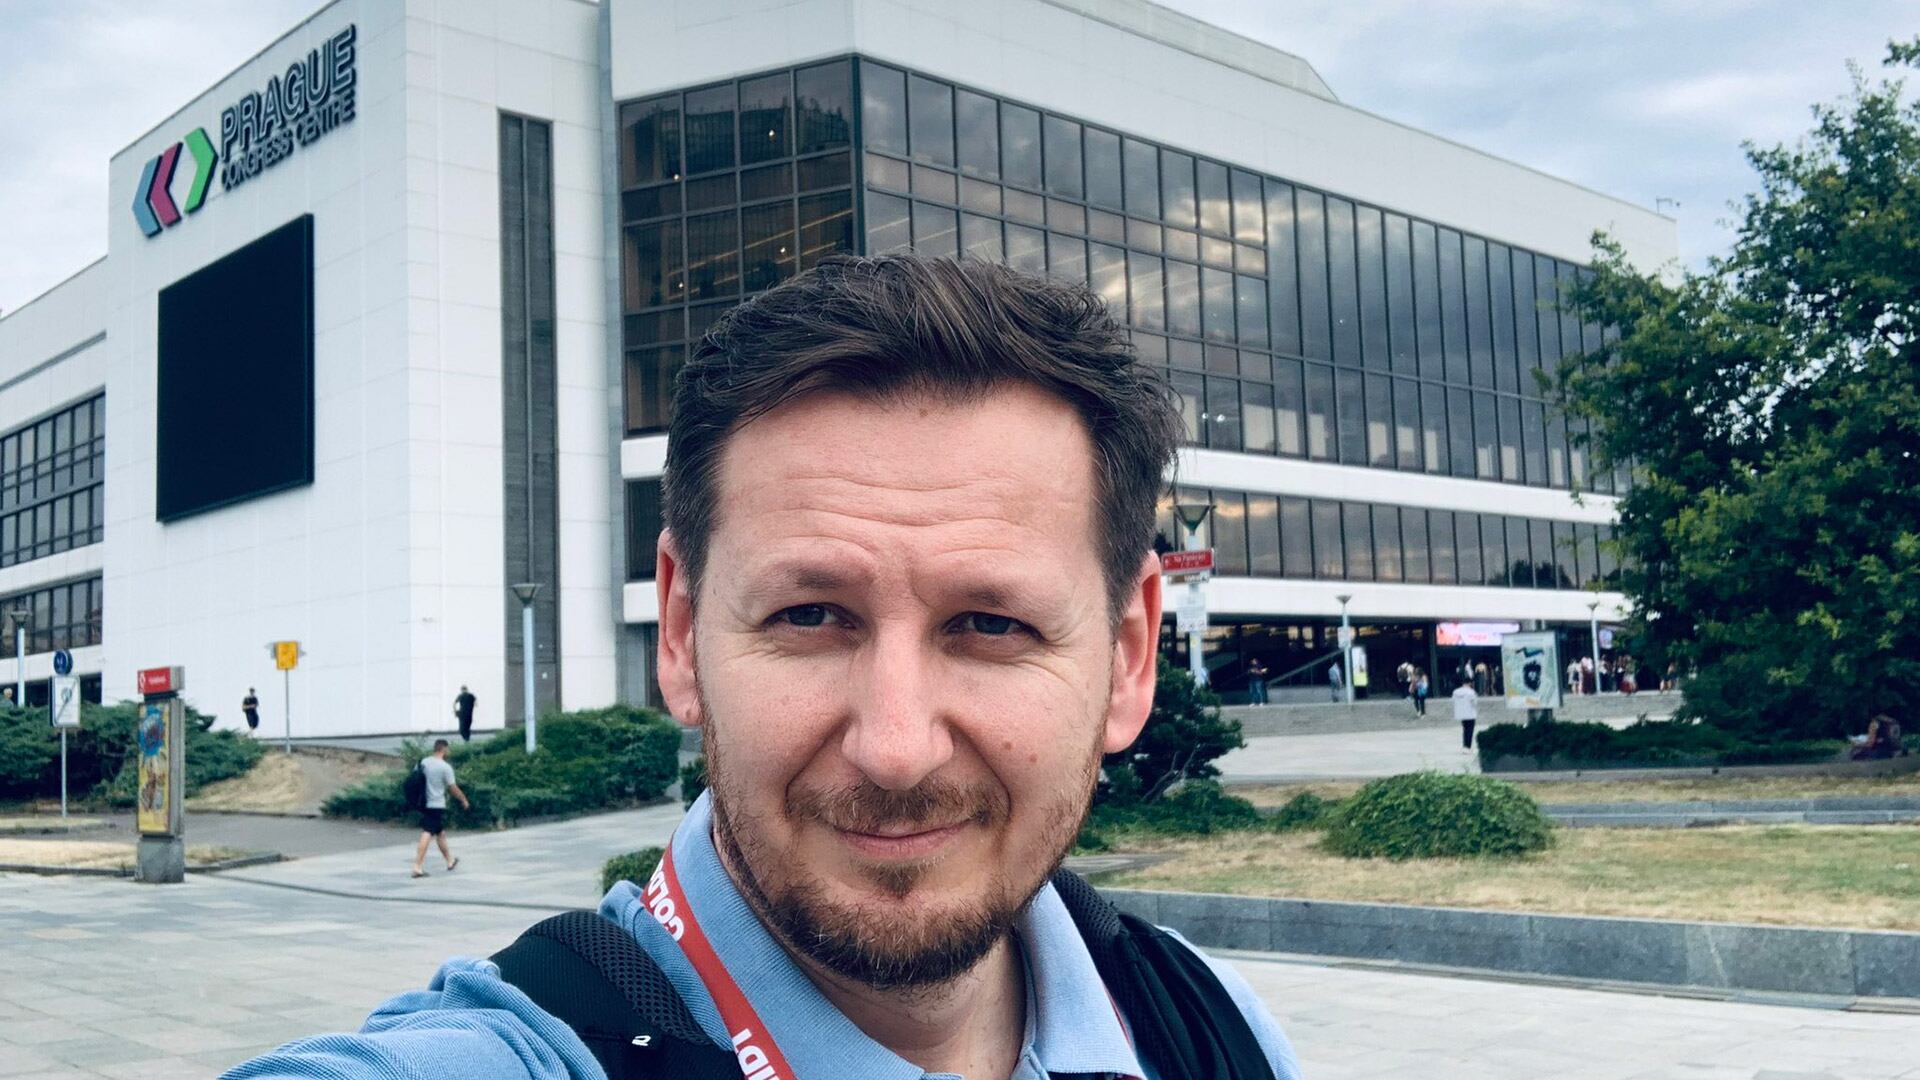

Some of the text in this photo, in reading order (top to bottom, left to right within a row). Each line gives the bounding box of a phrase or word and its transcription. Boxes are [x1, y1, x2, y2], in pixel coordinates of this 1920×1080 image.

[221, 24, 356, 163] PRAGUE
[221, 88, 356, 192] CONGRESS CENTRE
[647, 858, 684, 942] GOLD
[731, 1028, 781, 1080] IDT
